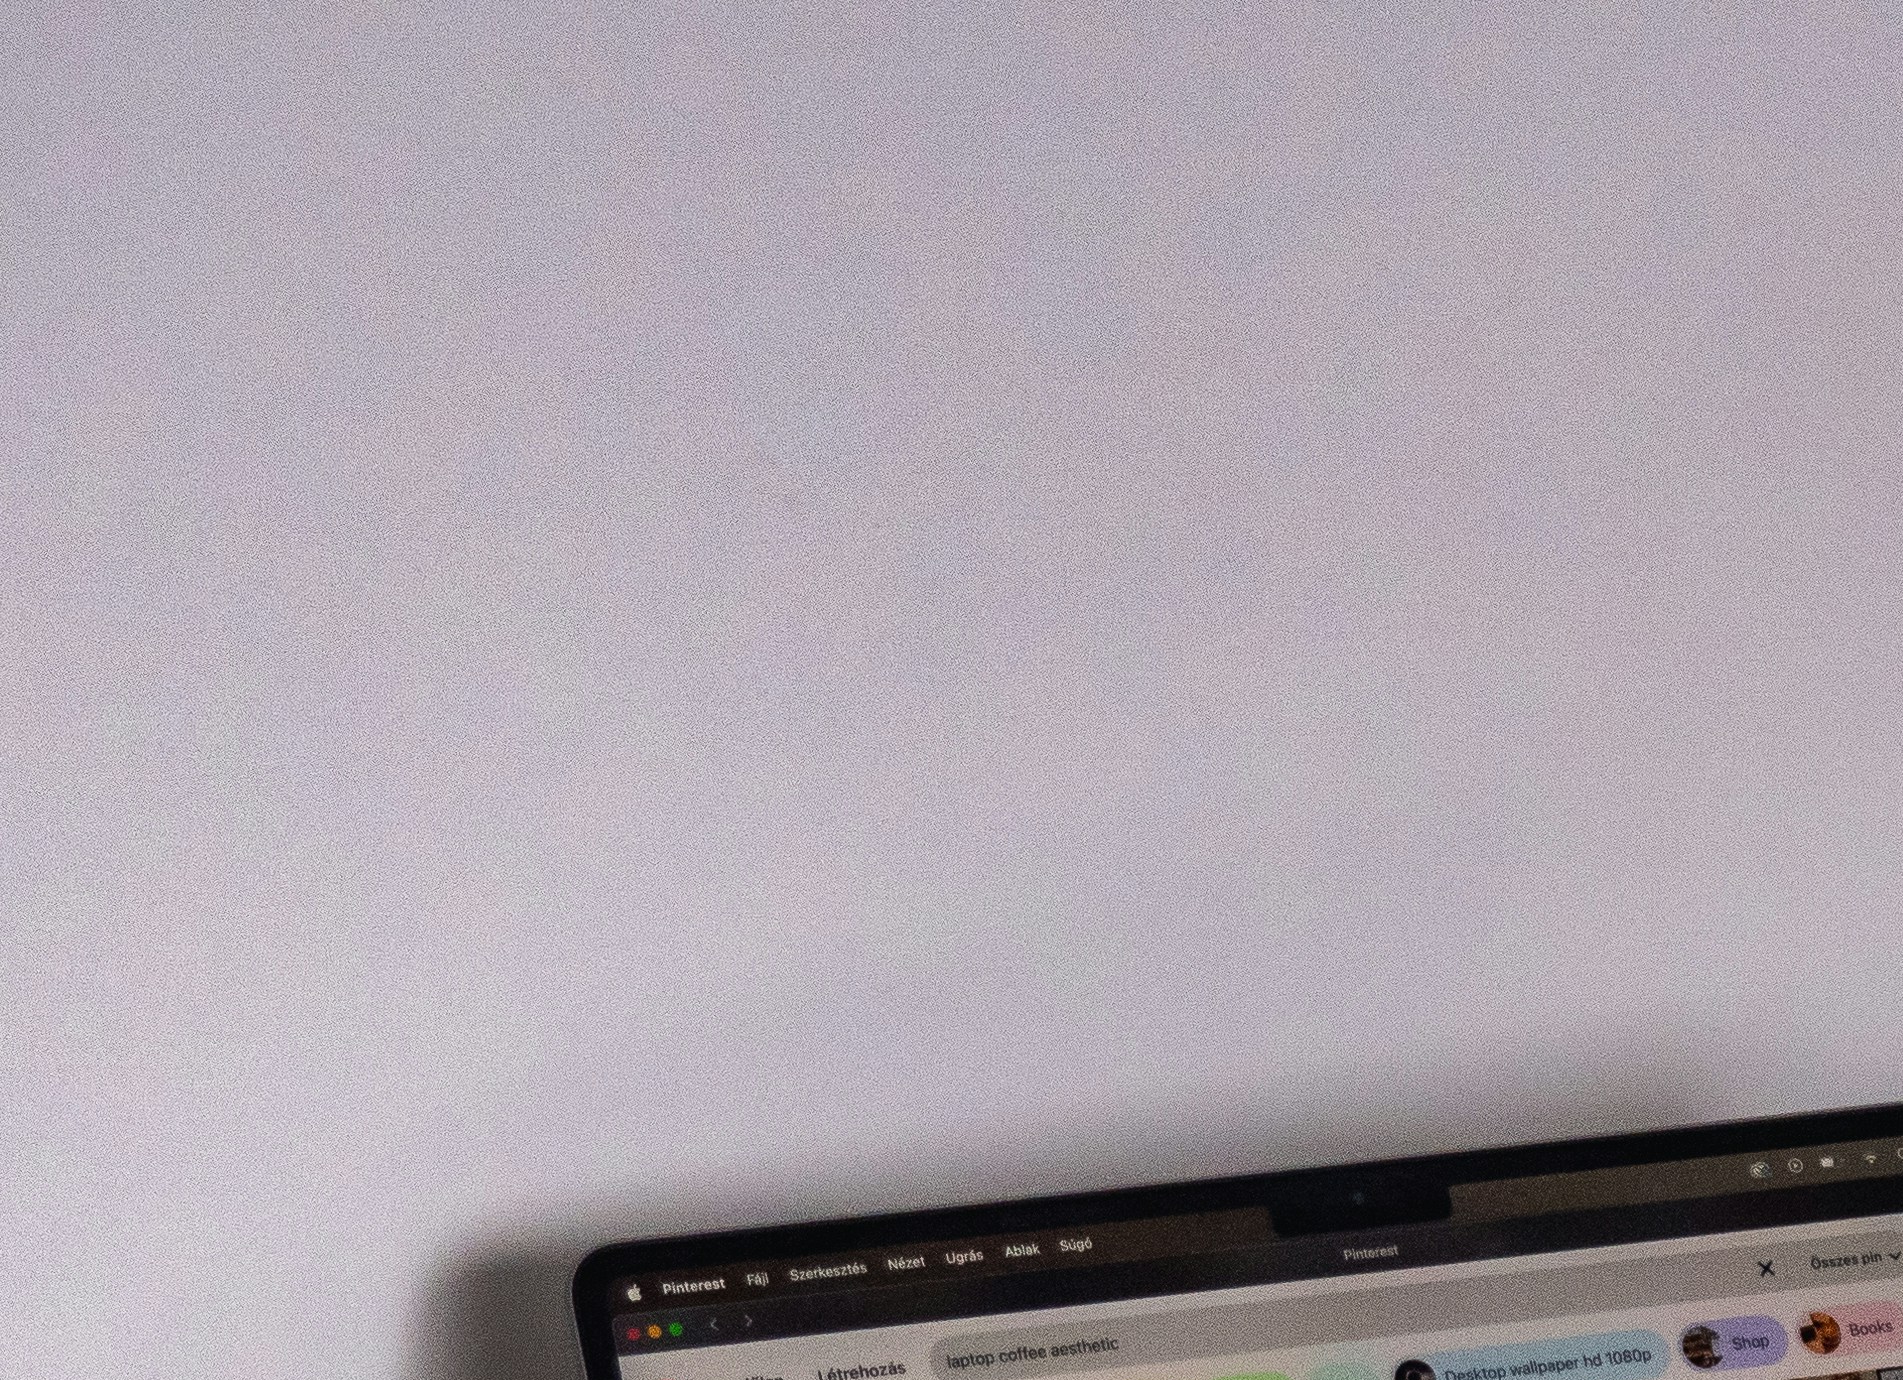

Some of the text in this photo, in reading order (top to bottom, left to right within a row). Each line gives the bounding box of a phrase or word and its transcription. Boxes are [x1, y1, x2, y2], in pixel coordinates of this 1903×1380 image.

[1004, 1243, 1042, 1258] Ablak
[1059, 1236, 1093, 1253] Súgó
[1342, 1245, 1399, 1261] Pinterest
[887, 1255, 926, 1271] Nézet
[945, 1248, 984, 1266] Ugrás
[1810, 1252, 1883, 1270] Összes pin
[745, 1271, 770, 1288] Fájl
[789, 1262, 868, 1283] Szerkesztés
[661, 1277, 727, 1296] Pinterest
[1849, 1321, 1893, 1337] Books
[1732, 1336, 1769, 1351] Shop
[946, 1337, 1120, 1370] laptop coffee aesthetic
[1510, 1357, 1579, 1377] wallpaper
[1583, 1353, 1602, 1367] hd
[1606, 1348, 1652, 1365] 1080p
